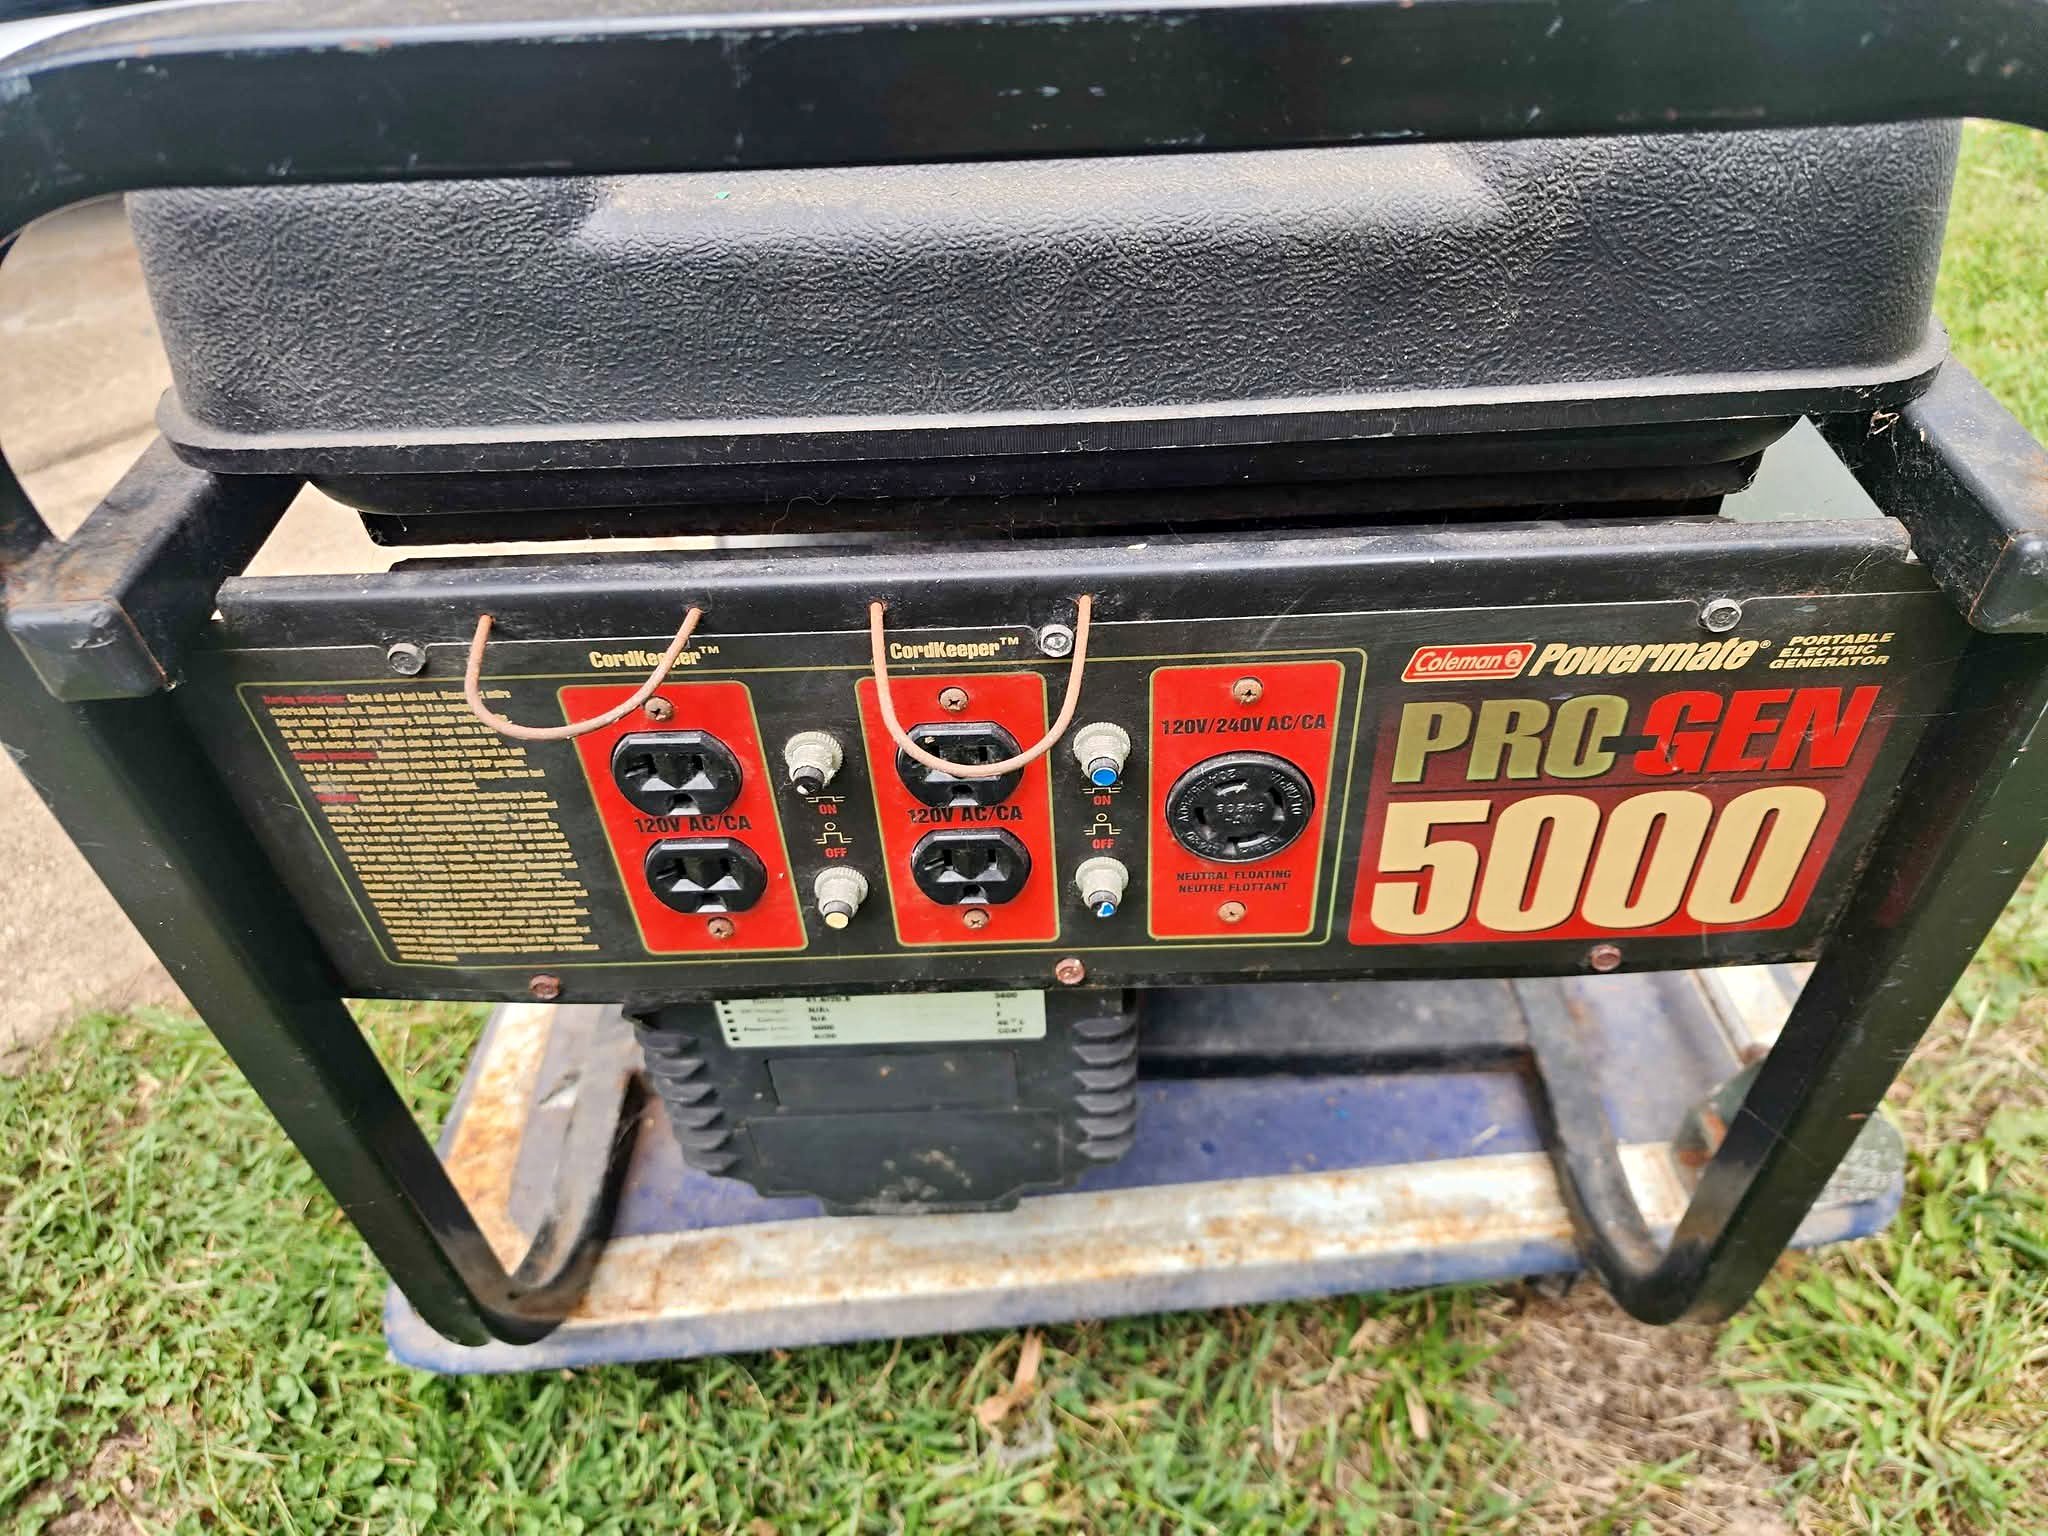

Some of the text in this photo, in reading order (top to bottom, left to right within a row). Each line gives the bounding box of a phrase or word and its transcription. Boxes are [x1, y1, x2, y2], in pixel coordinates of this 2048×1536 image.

[1789, 632, 1896, 646] PORTABLE
[1778, 645, 1878, 658] ELECTRIC
[1415, 651, 1502, 672] Coleman
[1769, 656, 1890, 669] GENERATOR
[1162, 714, 1326, 735] 120V/240V AC/CA
[1093, 795, 1112, 806] ON
[819, 803, 838, 815] ON
[908, 805, 1024, 824] 120V AC/CA
[634, 814, 752, 833] 120V AC/CA
[1092, 839, 1115, 850] OFF
[825, 847, 848, 858] OFF
[1370, 785, 1827, 936] 5000
[1177, 870, 1291, 881] NEUTRAL FLOATING
[1178, 882, 1288, 893] NEUTRE FLOTTANT
